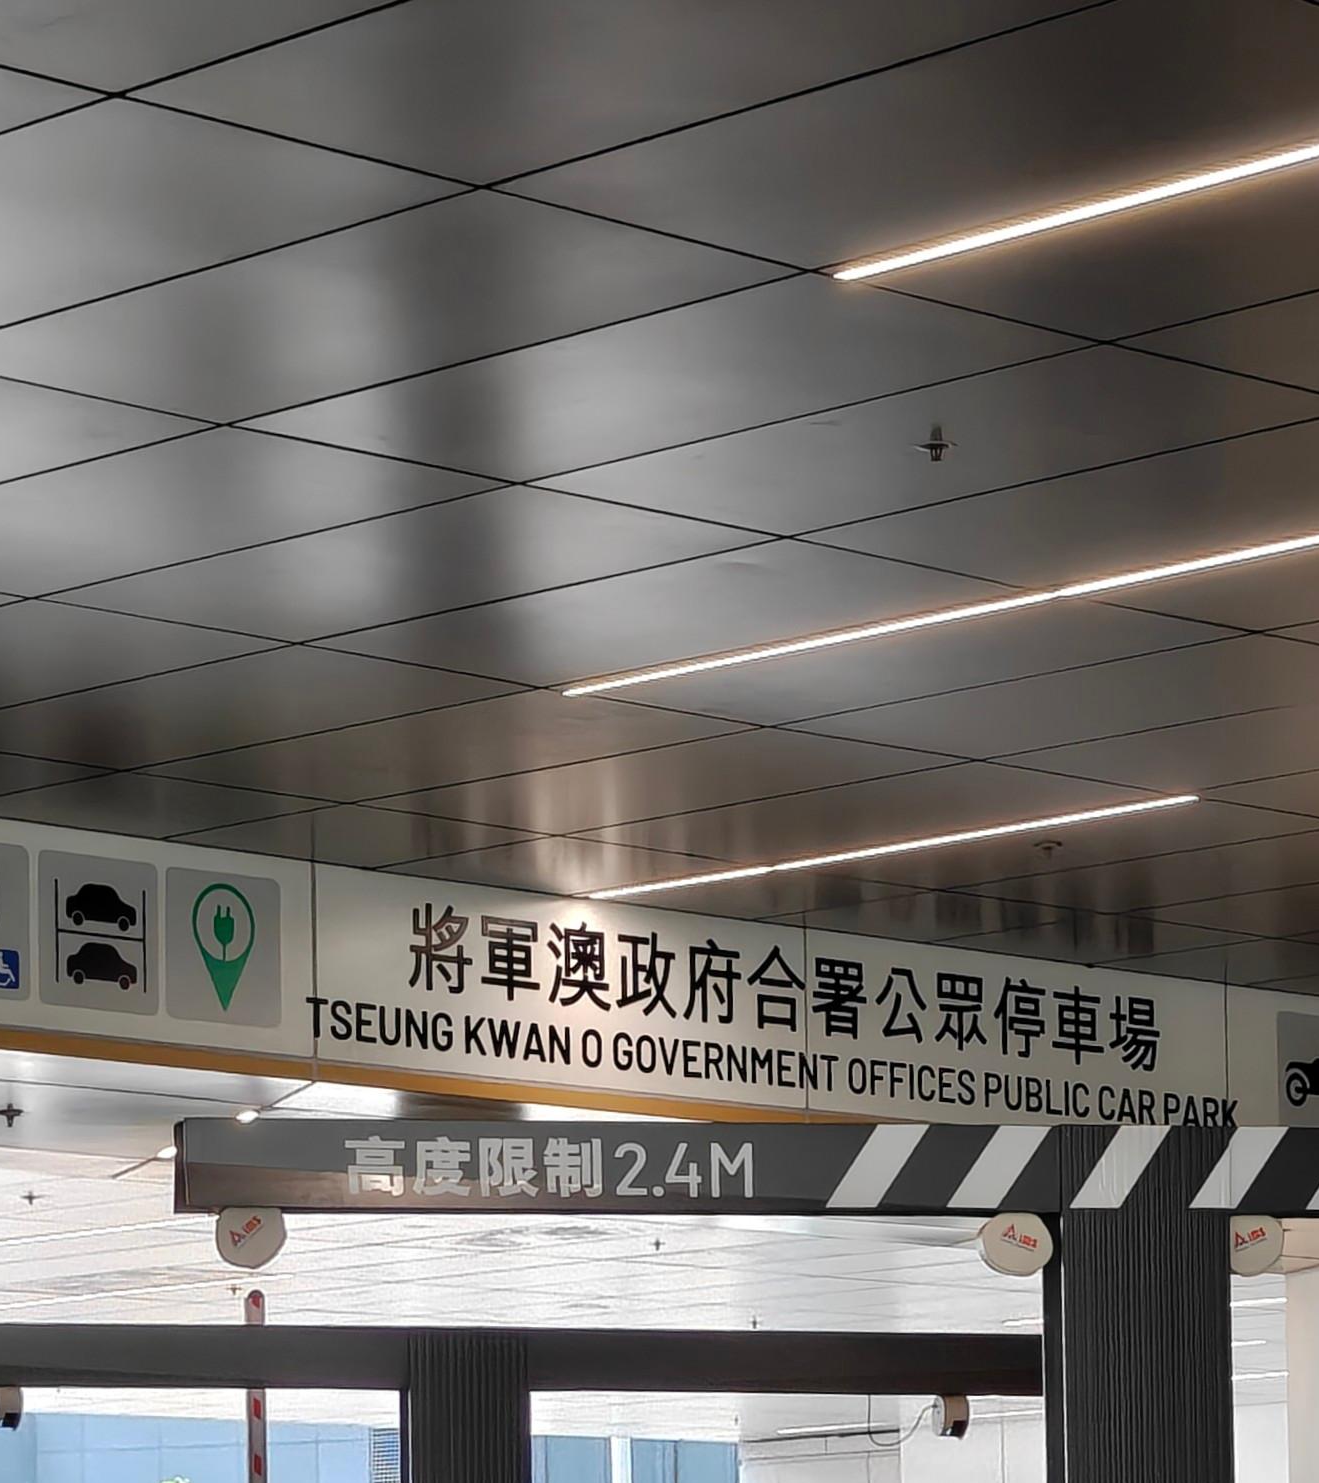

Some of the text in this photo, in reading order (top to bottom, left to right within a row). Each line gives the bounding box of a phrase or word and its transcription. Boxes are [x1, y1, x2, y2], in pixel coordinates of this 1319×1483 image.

[408, 902, 1161, 1072] 將軍澳政府合署公眾停車場
[306, 997, 1238, 1128] TSEUNG KWAN O GOVERNMENT OFFICES PUBLIC CAR PARK
[344, 1135, 754, 1198] 高度限制2.4M
